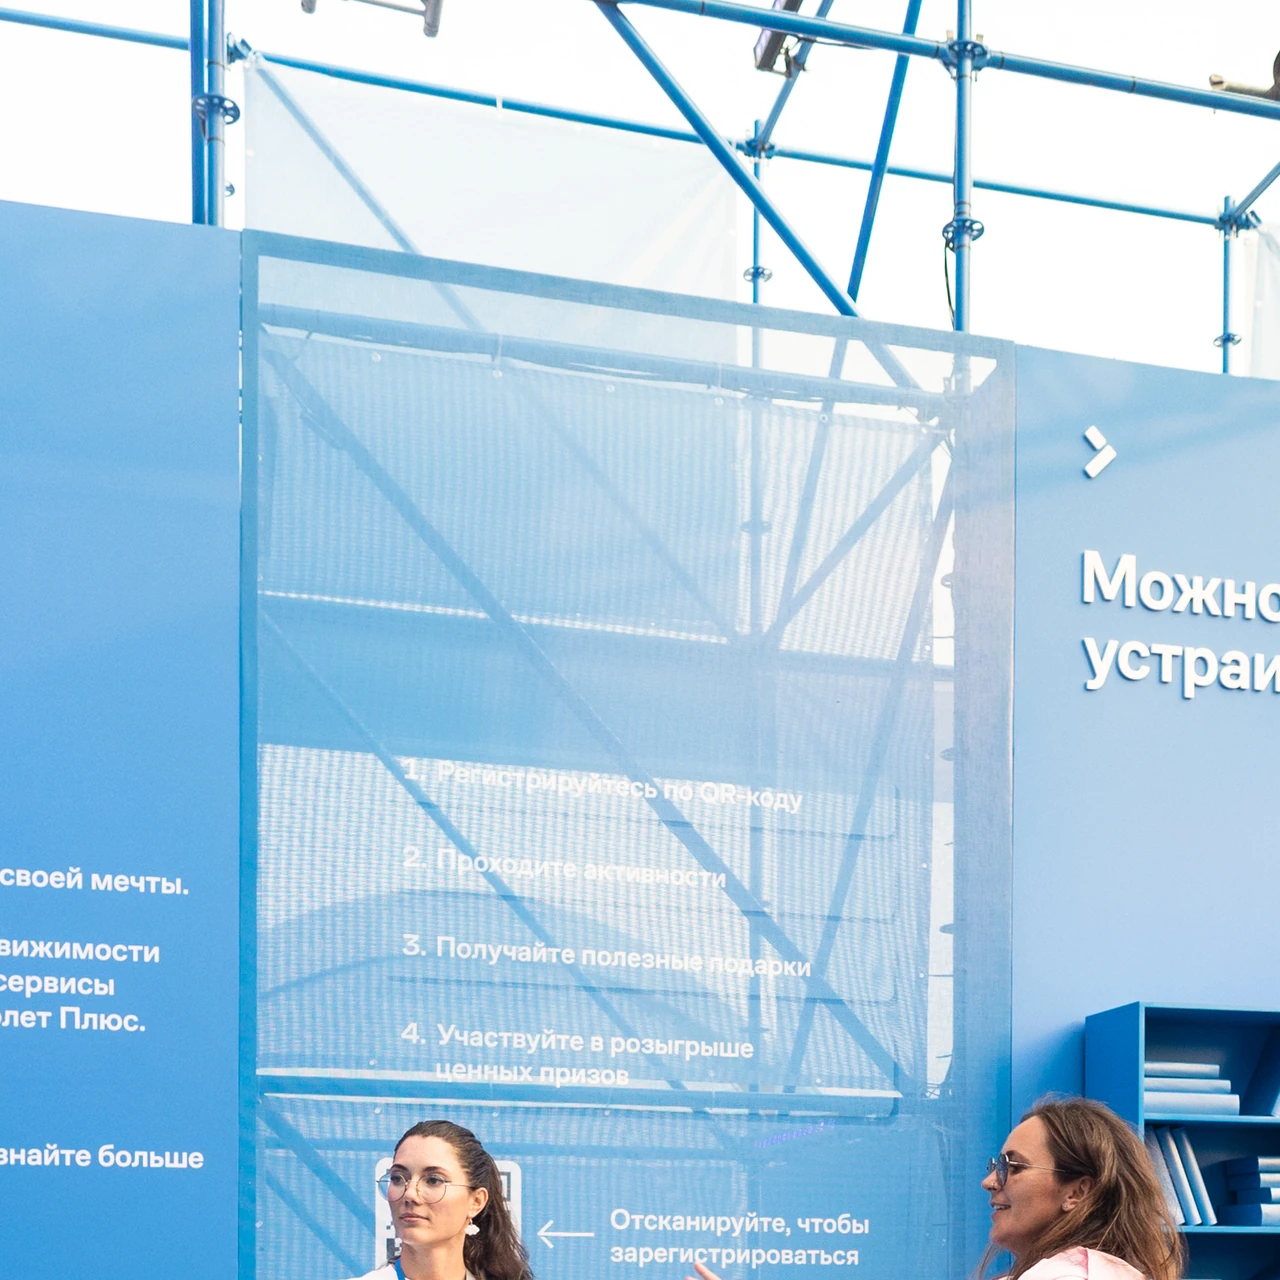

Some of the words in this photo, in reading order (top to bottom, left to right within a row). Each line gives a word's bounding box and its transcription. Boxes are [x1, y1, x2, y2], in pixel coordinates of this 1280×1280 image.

[403, 757, 428, 781] 1.
[437, 760, 658, 798] Регистрируйтесь
[663, 783, 694, 801] по
[699, 781, 803, 815] QR-коду
[402, 845, 427, 869] 2.
[437, 848, 577, 879] Проходите
[583, 863, 726, 888] активности
[91, 873, 189, 895] мечты.
[402, 933, 426, 957] 3.
[436, 935, 576, 965] Получайте
[582, 949, 703, 971] полезные
[709, 957, 811, 979] подарки
[59, 1006, 146, 1032] Плюс.
[400, 1022, 426, 1045] 4.
[436, 1023, 585, 1054] Участвуйте
[591, 1035, 604, 1051] в
[610, 1035, 755, 1060] розыгрыше
[436, 1062, 533, 1083] ценных
[540, 1066, 629, 1088] призов
[98, 1143, 205, 1169] больше
[610, 1208, 791, 1237] Отсканируйте,
[797, 1213, 870, 1235] чтобы
[609, 1244, 860, 1268] зарегистрироваться
